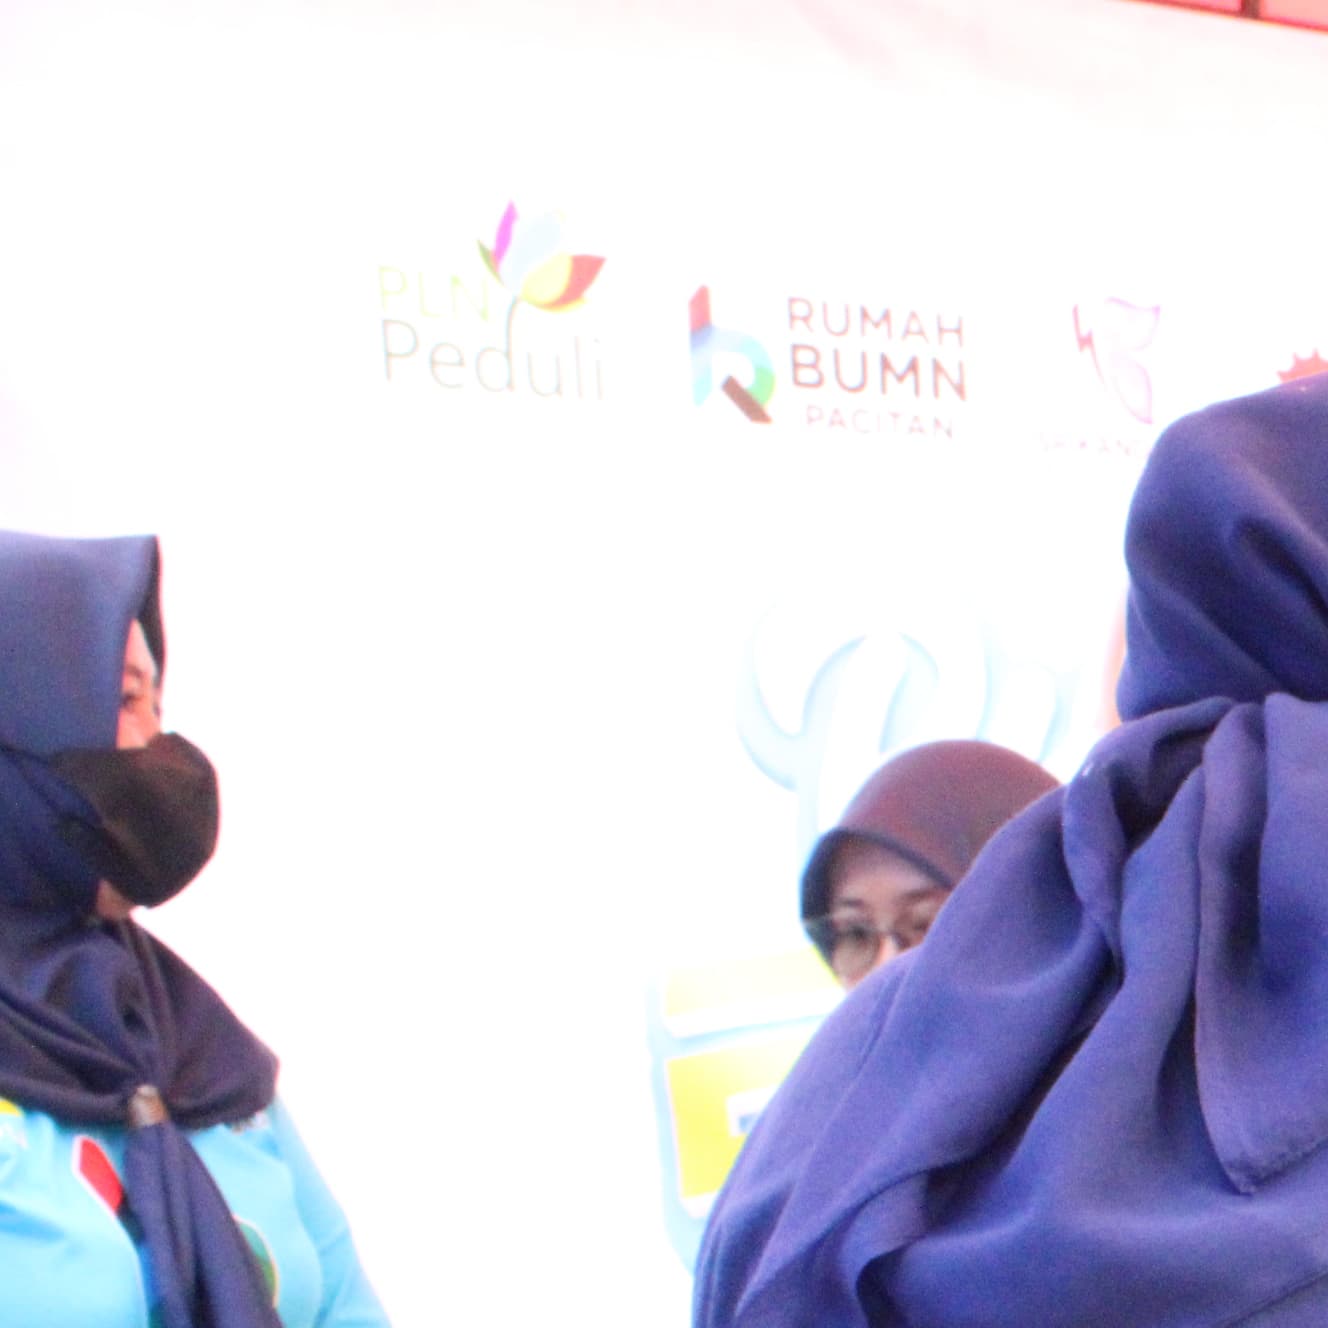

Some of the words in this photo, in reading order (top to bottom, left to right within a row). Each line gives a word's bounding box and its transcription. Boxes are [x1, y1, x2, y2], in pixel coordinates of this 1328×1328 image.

[377, 264, 490, 322] PLN
[787, 296, 964, 348] RUMAH
[382, 317, 603, 401] Peduli
[790, 342, 967, 402] BUMN
[806, 404, 953, 440] PACITAN
